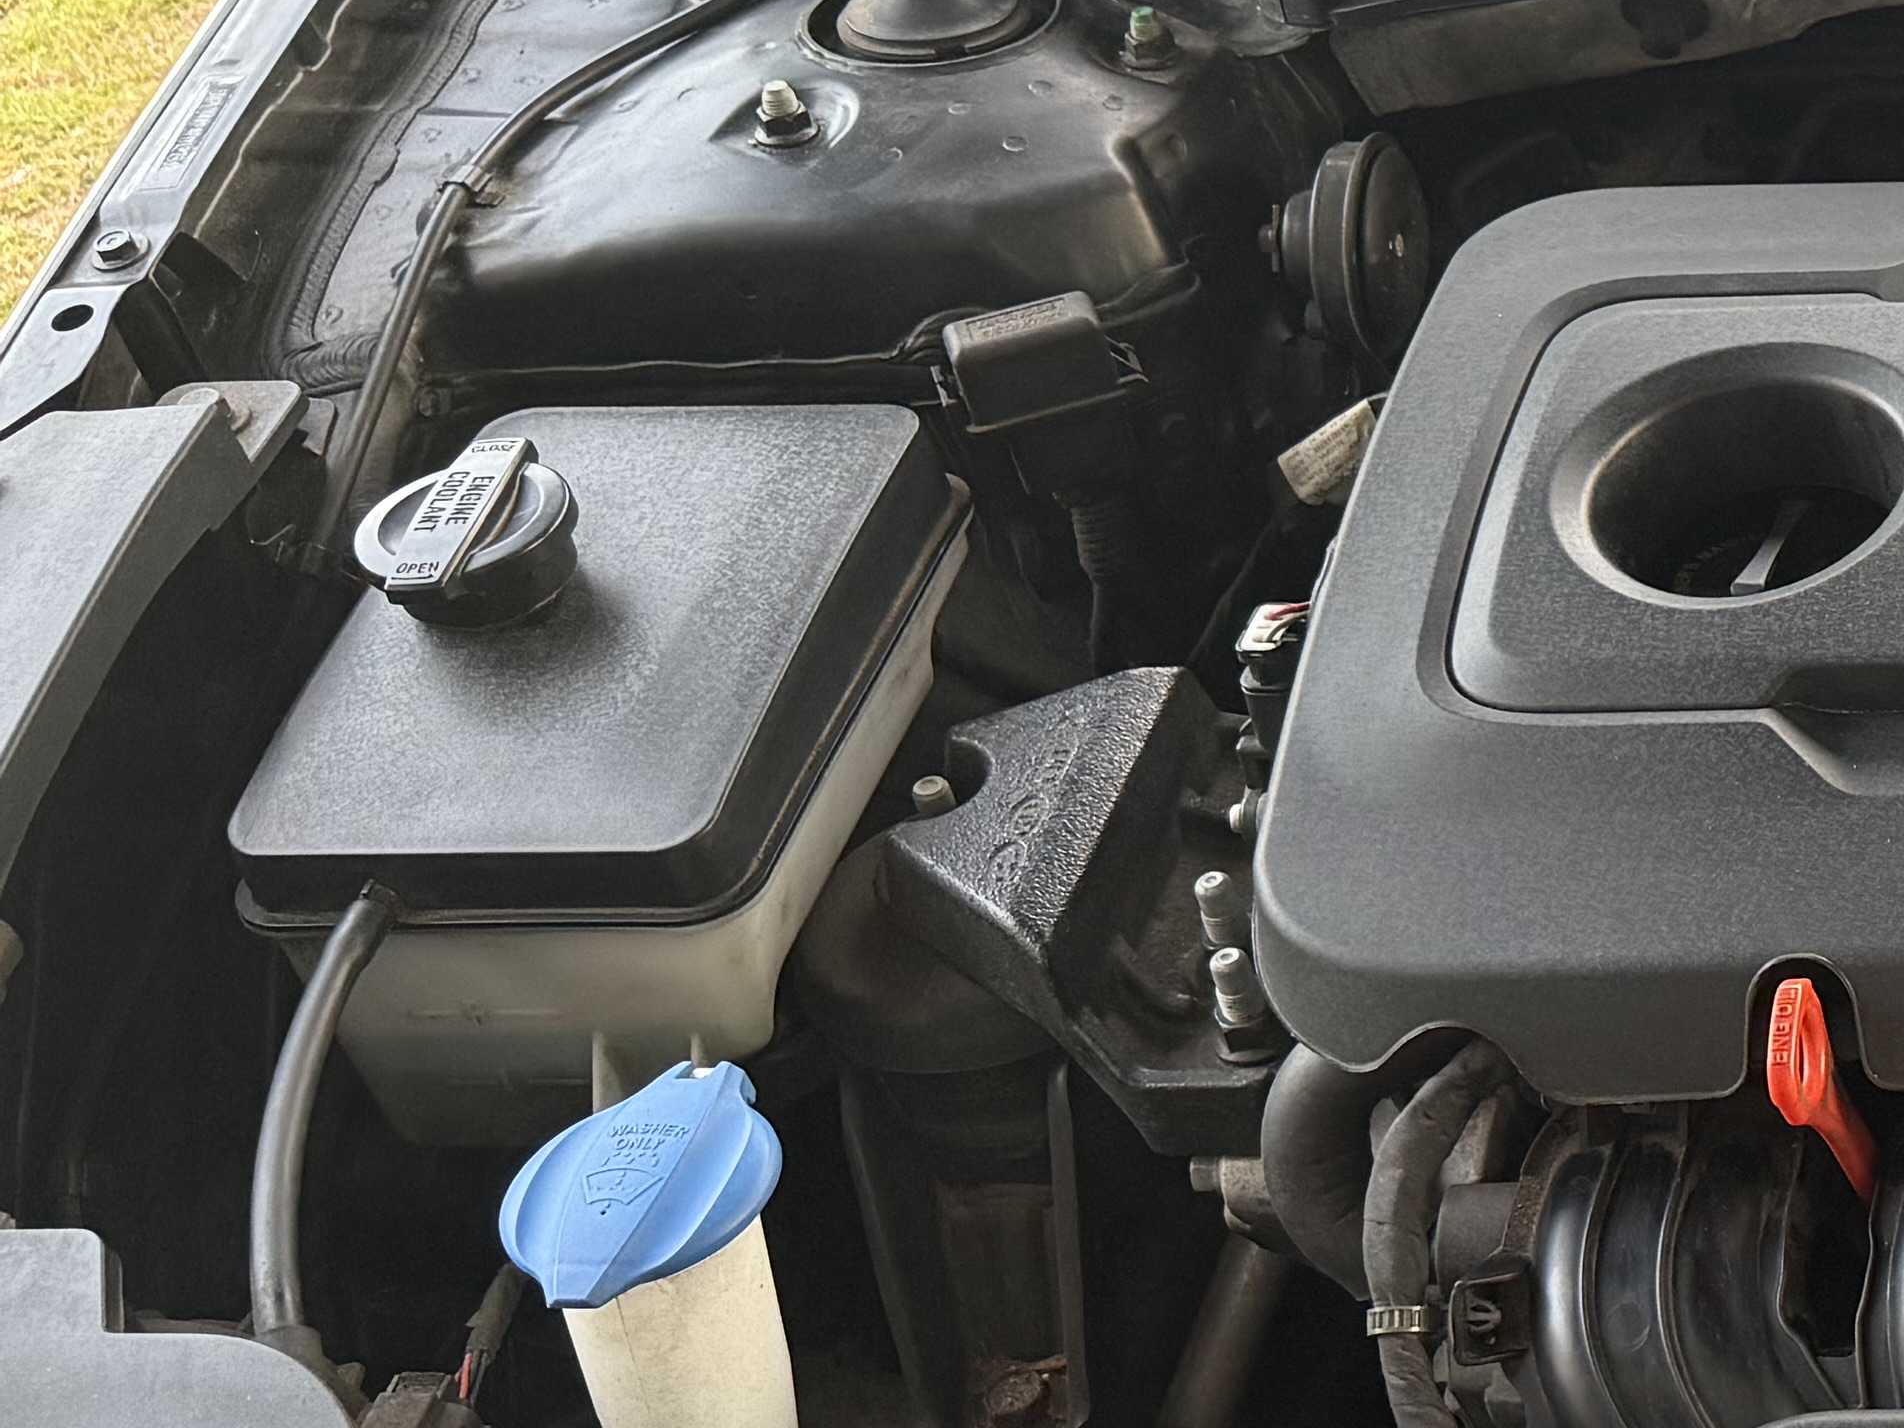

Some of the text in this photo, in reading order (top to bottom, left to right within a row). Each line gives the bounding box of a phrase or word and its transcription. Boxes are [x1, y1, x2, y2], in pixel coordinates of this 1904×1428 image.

[413, 471, 470, 533] COOLANT
[453, 475, 495, 525] ENGINE
[396, 560, 439, 574] OPEN
[1771, 1021, 1791, 1066] ENG
[611, 1123, 690, 1139] WASHER
[614, 1138, 665, 1151] ONLY
